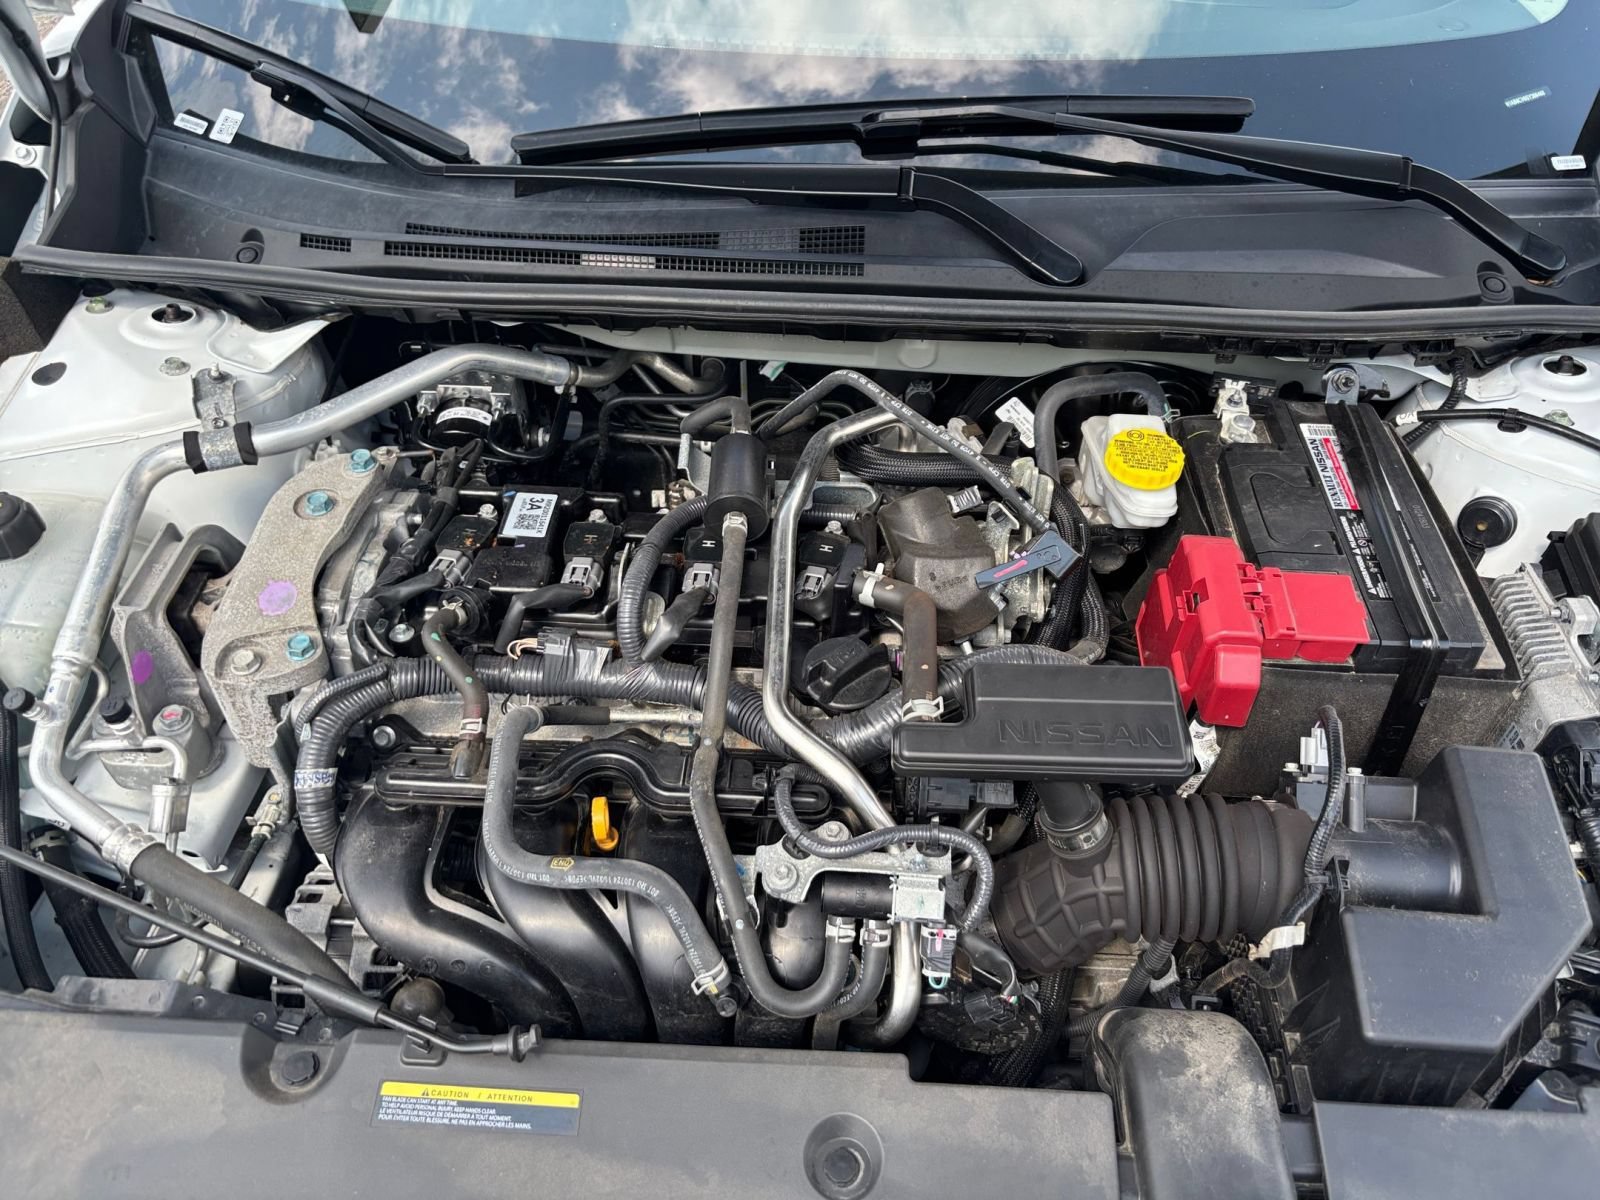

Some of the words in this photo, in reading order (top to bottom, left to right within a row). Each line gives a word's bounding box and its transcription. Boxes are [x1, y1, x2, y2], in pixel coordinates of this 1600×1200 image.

[1308, 438, 1329, 472] NISSAN
[526, 497, 545, 511] 3A
[1322, 476, 1344, 508] RENAULT
[998, 718, 1172, 747] NISSAN
[431, 1089, 469, 1098] CAUTION
[488, 1093, 533, 1102] ATTENTION
